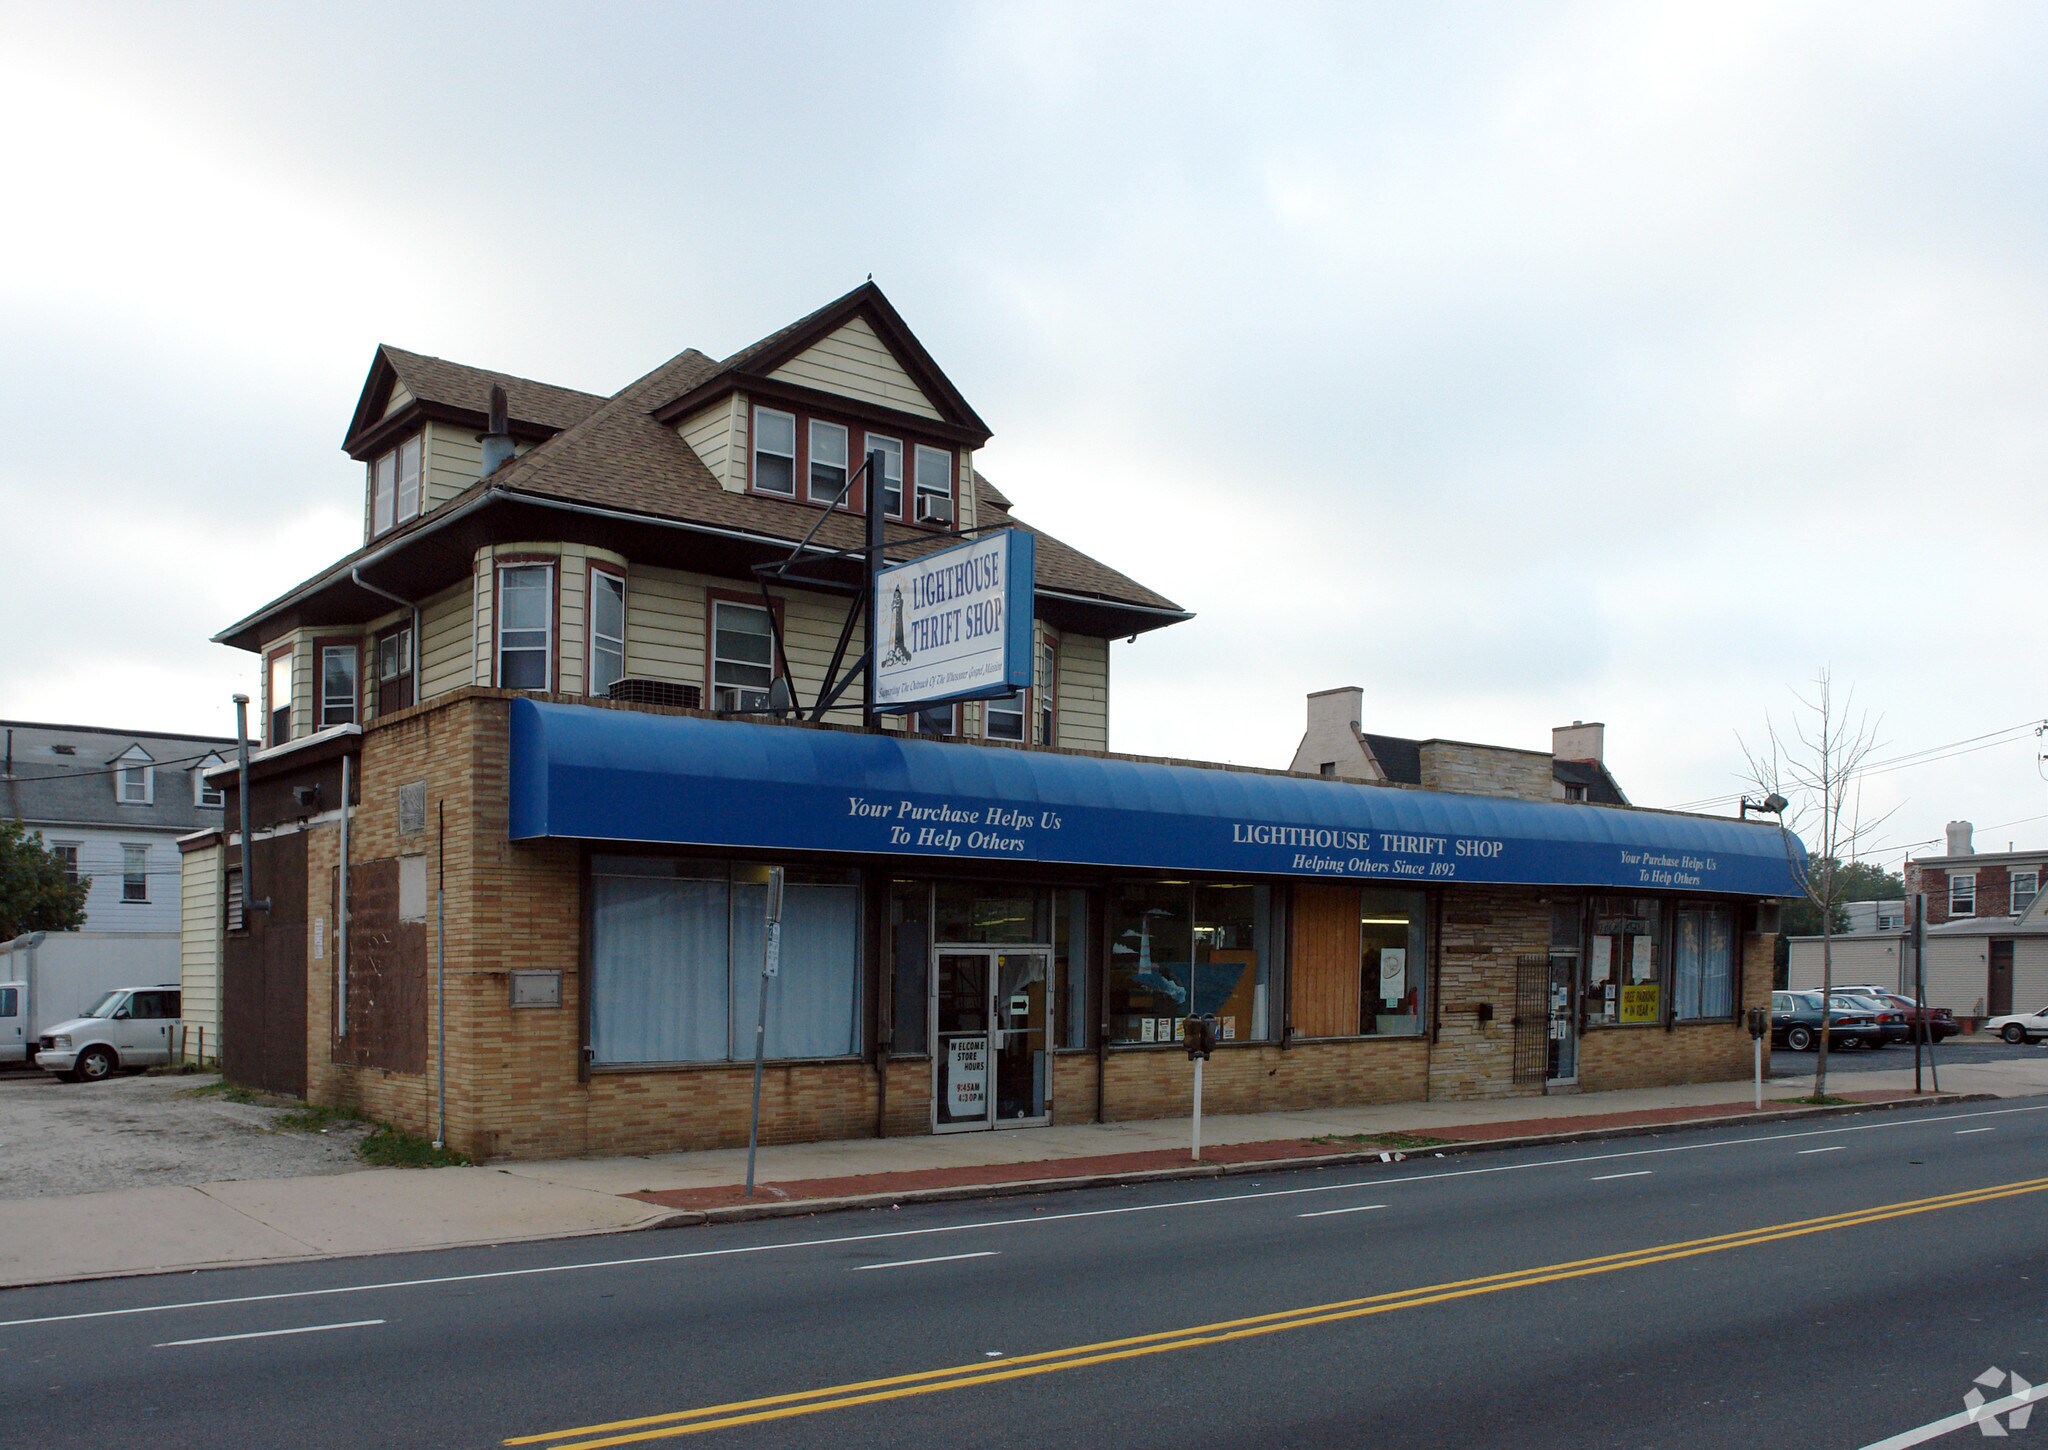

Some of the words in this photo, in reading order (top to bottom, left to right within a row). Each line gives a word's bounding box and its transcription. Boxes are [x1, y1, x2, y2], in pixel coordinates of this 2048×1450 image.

[912, 551, 999, 610] LIGHTHOUSE
[911, 608, 962, 653] THRIFT
[966, 597, 1002, 640] SHOP
[848, 796, 892, 818] Your
[896, 800, 979, 824] Purchase
[986, 807, 1034, 831] Helps
[1040, 811, 1062, 830] Us
[890, 826, 911, 846] To
[916, 827, 962, 851] Help
[968, 831, 1025, 852] Others
[1232, 824, 1370, 851] LIGHTHOUSE
[1380, 834, 1446, 856] THRIFT
[1455, 838, 1504, 858] SHOP
[1292, 854, 1344, 874] Helping
[1348, 857, 1390, 874] Others
[1392, 860, 1426, 875] Since
[1429, 862, 1456, 877] 1892
[1620, 850, 1641, 864] Your
[1642, 852, 1680, 868] Purchase
[1682, 856, 1704, 872] Helps
[1706, 858, 1717, 870] Us
[1640, 868, 1650, 882] To
[1652, 870, 1672, 886] Help
[1674, 872, 1700, 886] Others
[957, 1052, 977, 1062] STORE
[964, 1062, 984, 1071] HOURS
